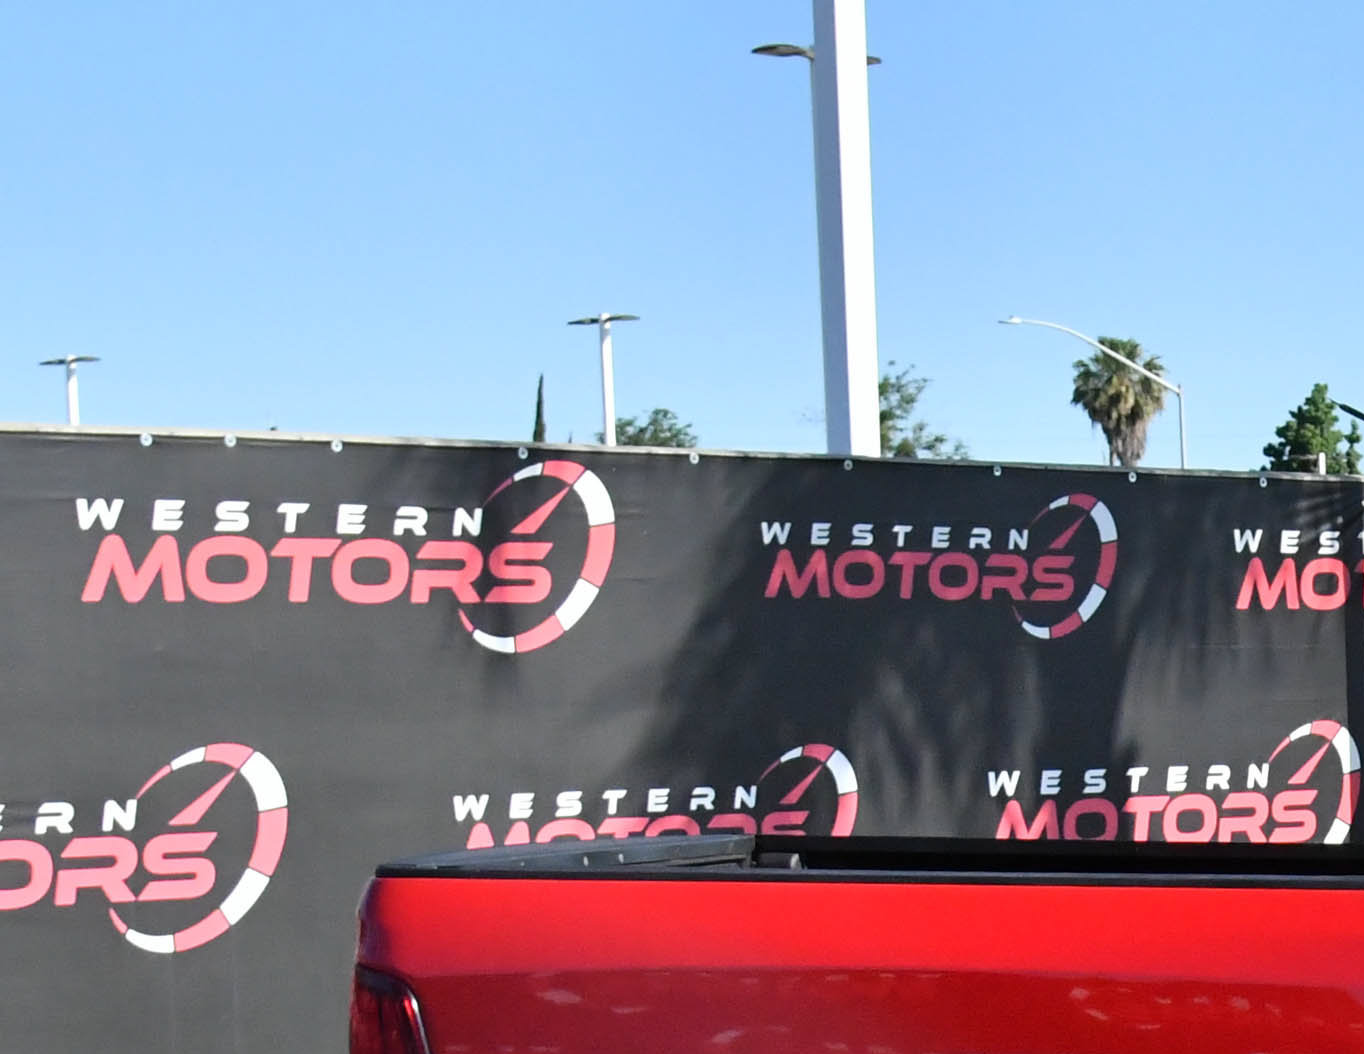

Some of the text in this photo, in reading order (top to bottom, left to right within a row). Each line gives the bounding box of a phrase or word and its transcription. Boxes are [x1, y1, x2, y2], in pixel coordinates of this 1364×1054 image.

[76, 498, 483, 536] WESTERN
[761, 521, 1029, 551] WESTERN
[81, 534, 553, 604] MOTORS
[764, 548, 1074, 601] MOTORS
[988, 763, 1269, 797] WESTERN
[453, 785, 757, 821] WESTERN
[995, 790, 1318, 844] MOTORS
